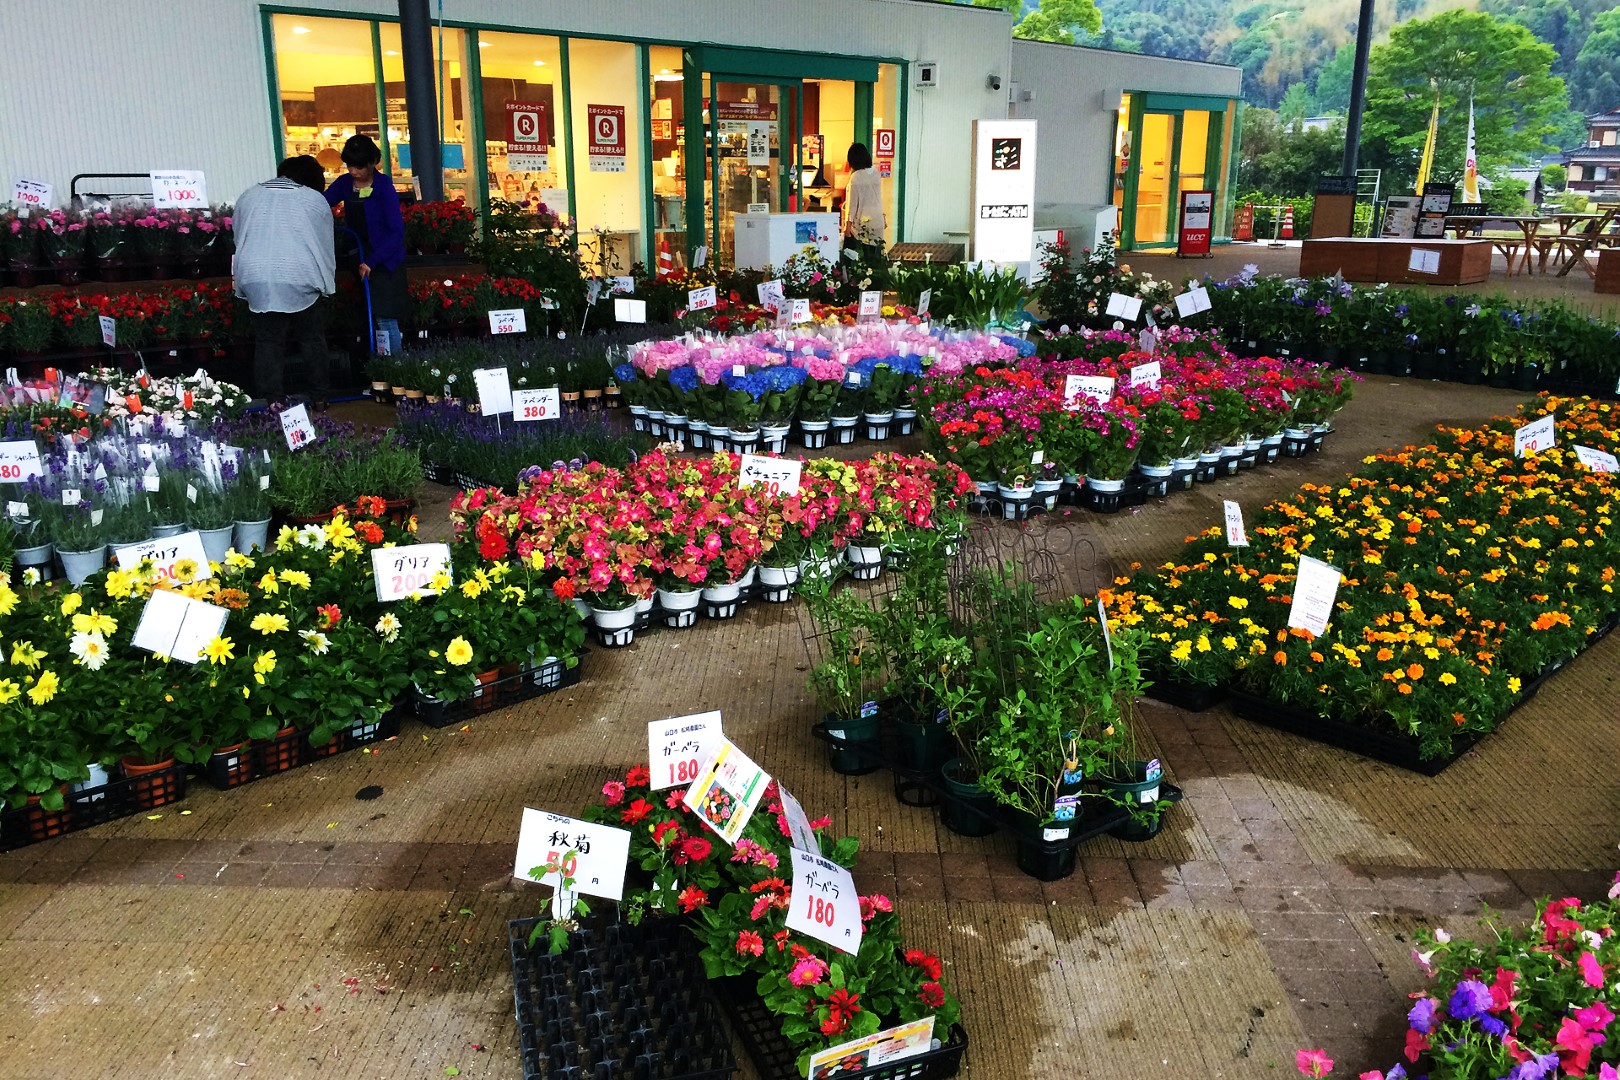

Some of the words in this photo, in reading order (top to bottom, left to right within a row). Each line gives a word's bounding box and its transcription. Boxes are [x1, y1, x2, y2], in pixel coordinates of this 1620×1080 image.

[522, 119, 532, 132] R
[603, 122, 611, 135] R
[16, 191, 40, 203] 1000
[168, 189, 196, 201] 1000
[498, 325, 513, 333] 550
[522, 395, 553, 405] ラベンダー
[524, 406, 546, 418] 380
[1524, 439, 1537, 451] 50
[0, 464, 21, 479] 80
[743, 465, 791, 481] ペチュニア
[1593, 462, 1608, 472] 50
[141, 546, 178, 562] ダリア
[394, 555, 429, 571] ダリア
[392, 572, 429, 594] 200
[663, 741, 701, 757] ガーベラ
[669, 758, 699, 785] 180
[546, 814, 571, 825] こちらの
[546, 830, 592, 855] 秋菊
[546, 850, 577, 879] 50
[591, 877, 600, 885] 円
[805, 870, 840, 900] ガーベラ
[807, 895, 835, 927] 180
